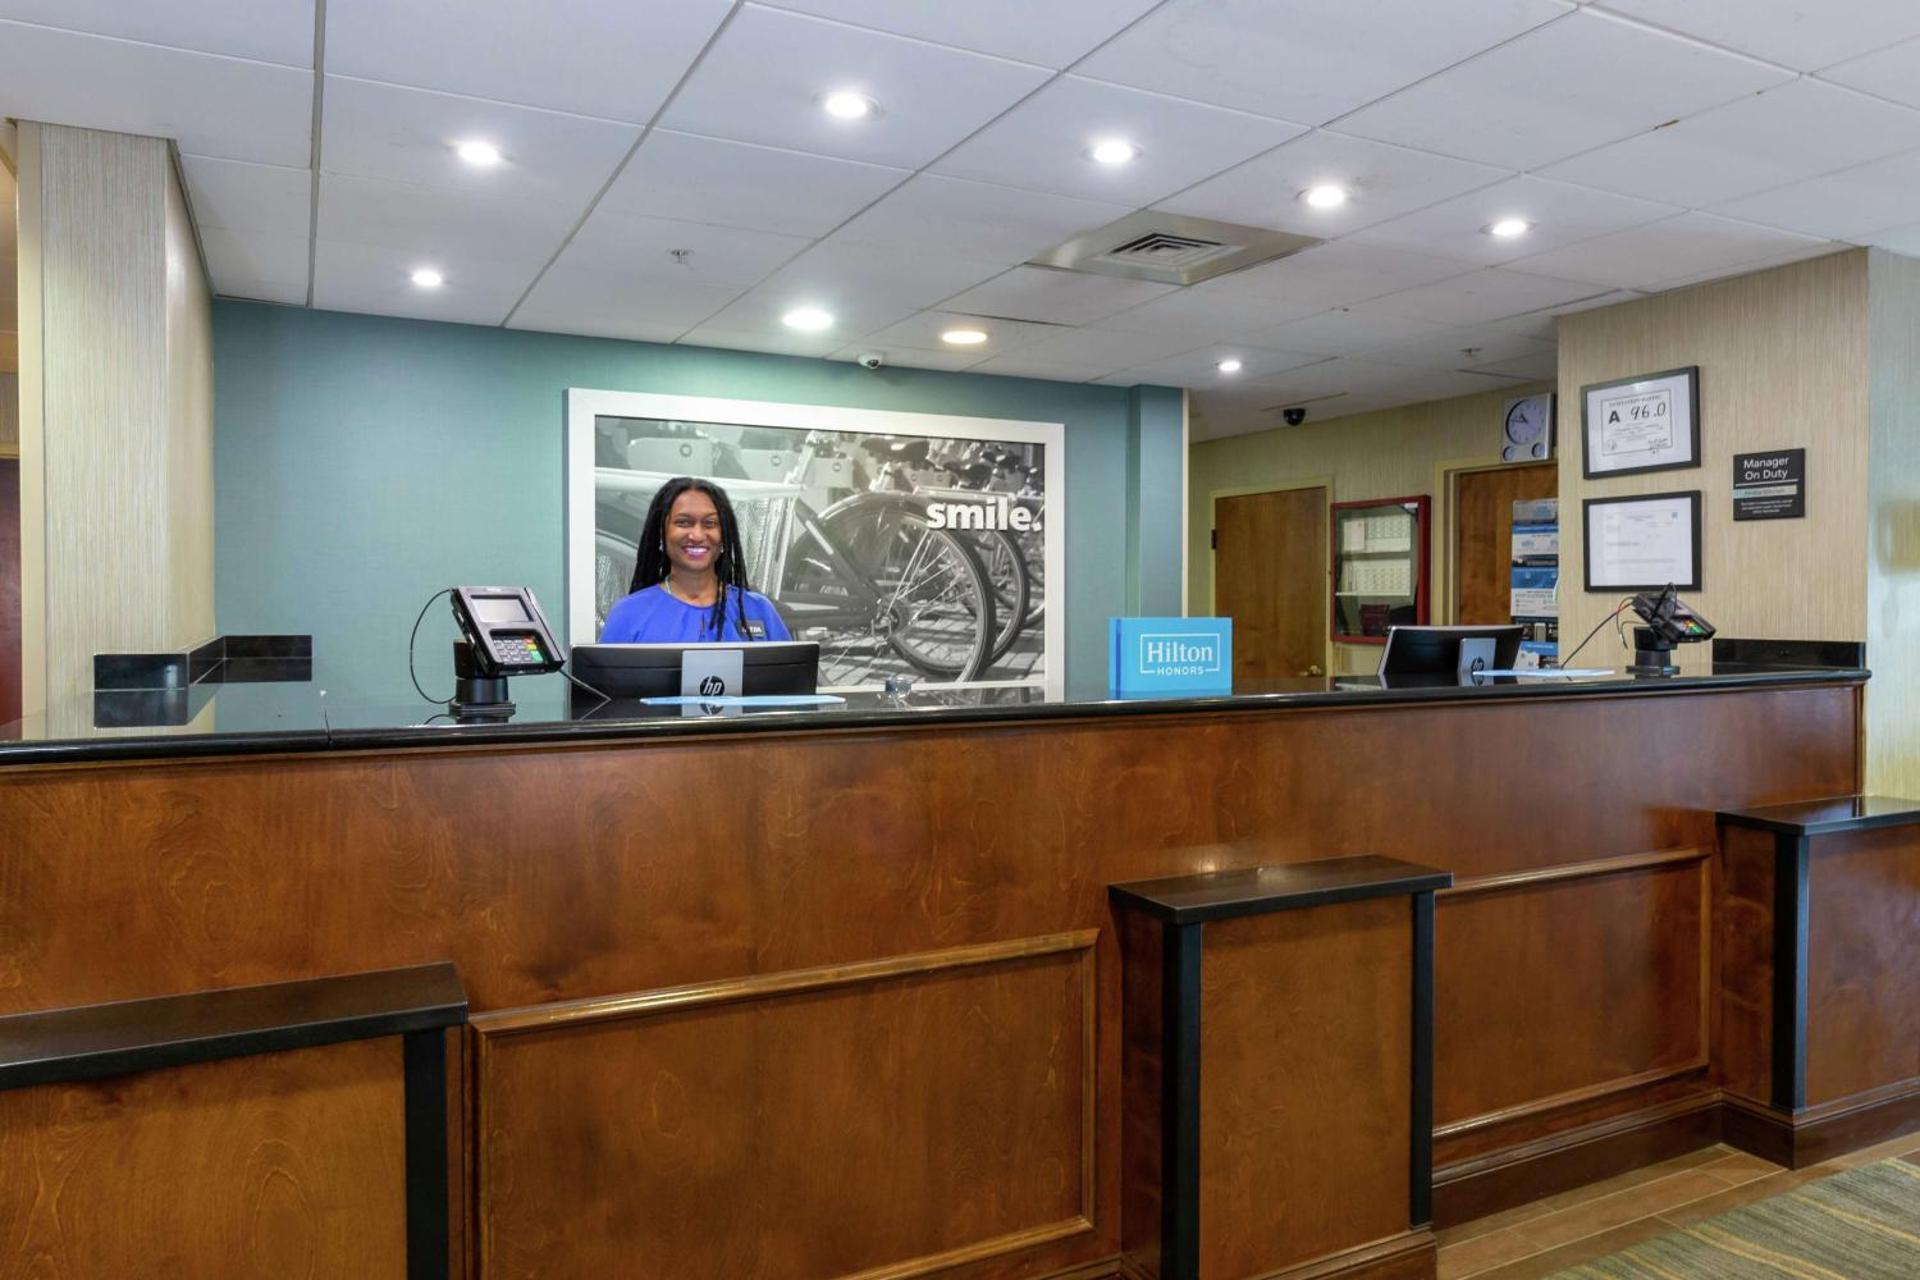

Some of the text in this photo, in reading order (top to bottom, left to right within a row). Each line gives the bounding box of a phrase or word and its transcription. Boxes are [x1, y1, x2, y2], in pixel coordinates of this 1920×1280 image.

[1609, 410, 1620, 424] A
[1630, 401, 1666, 420] 96.0
[1743, 457, 1790, 469] Manager
[1744, 469, 1788, 480] On Duty
[926, 496, 1042, 532] smile.
[1147, 641, 1213, 663] Hilton
[1157, 665, 1204, 676] HONORS
[703, 675, 722, 697] hp
